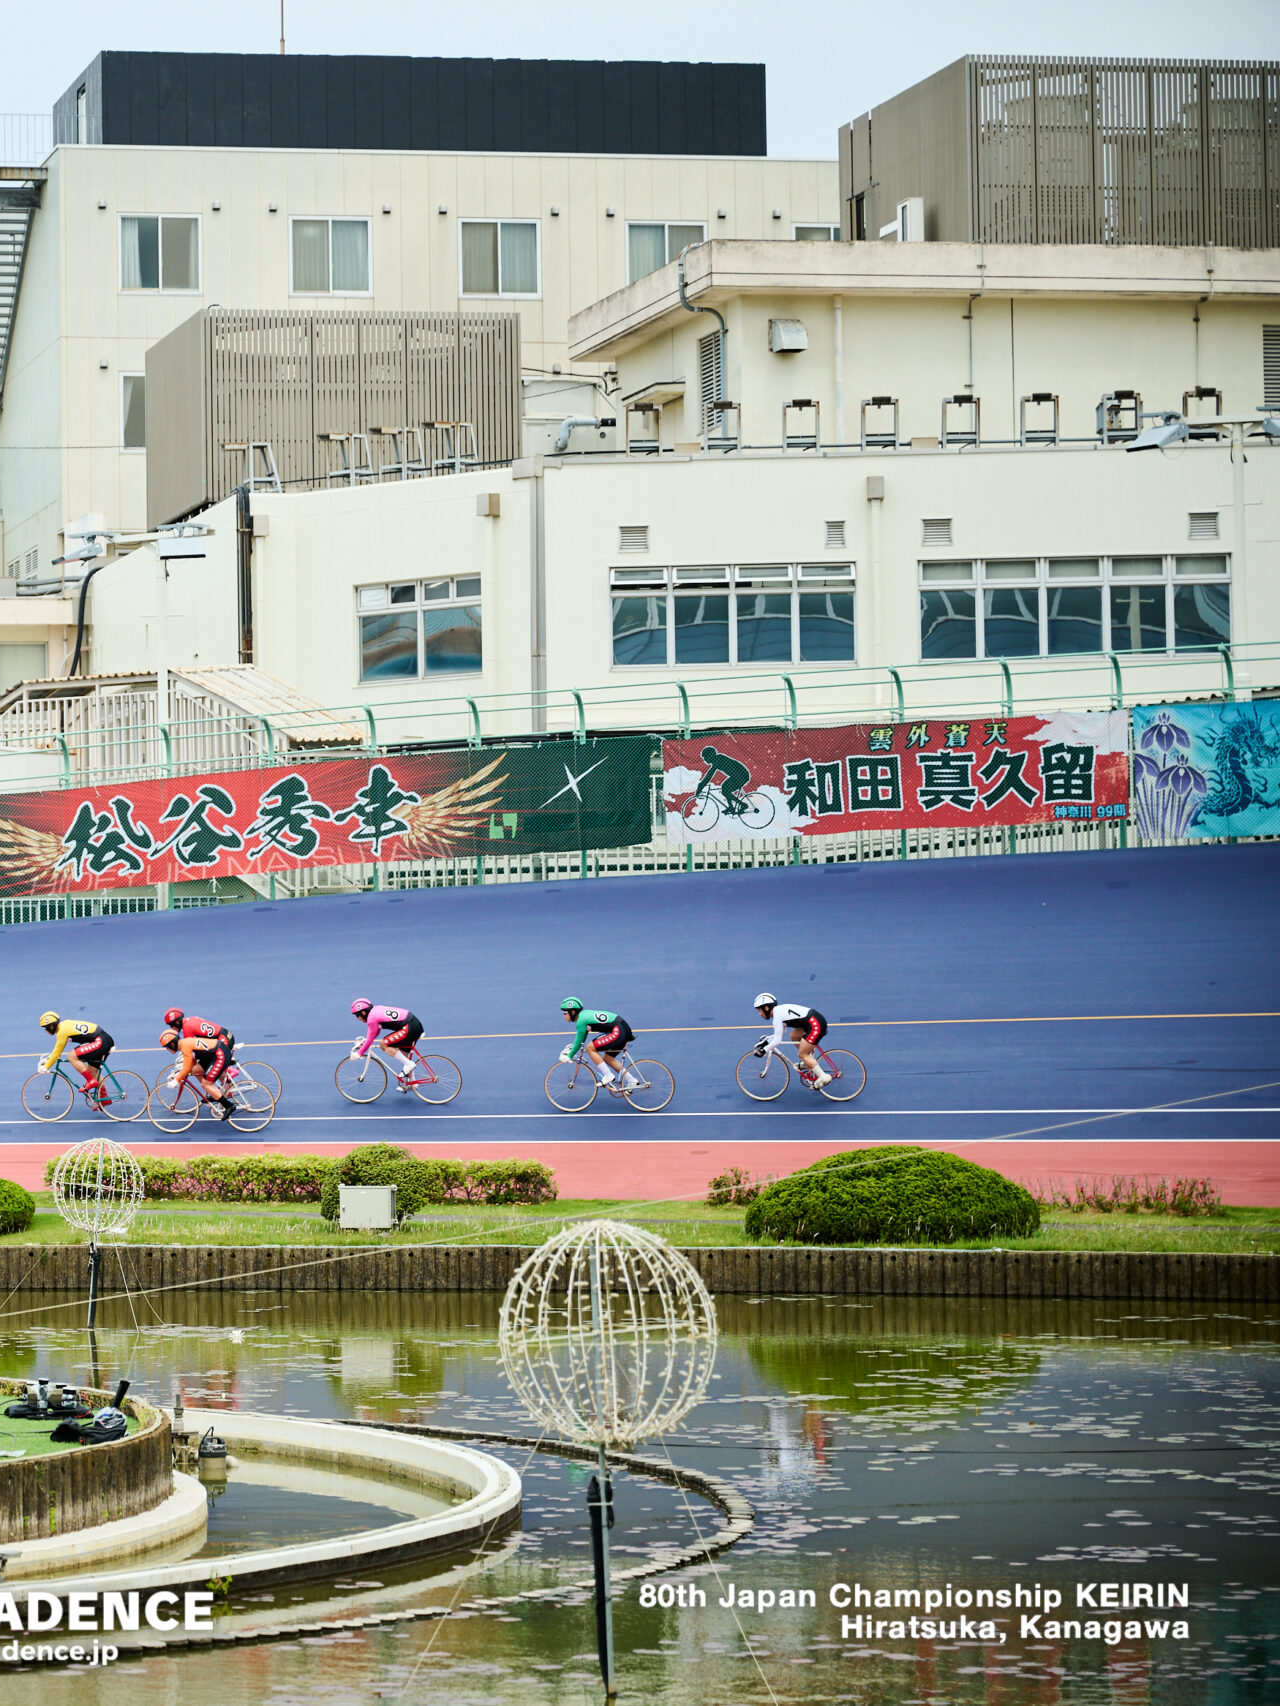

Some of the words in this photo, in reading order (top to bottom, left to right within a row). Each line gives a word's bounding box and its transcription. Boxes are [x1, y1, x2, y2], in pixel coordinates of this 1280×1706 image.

[869, 722, 1008, 751] 雲外蒼天
[783, 754, 904, 817] 和田
[917, 743, 1096, 812] 真久留
[1054, 804, 1092, 818] 神奈川
[1096, 803, 1126, 818] 99期
[55, 763, 421, 883] 松谷秀幸
[385, 1009, 399, 1021] 8
[594, 1012, 609, 1024] 6
[787, 1008, 801, 1018] 1
[75, 1023, 89, 1035] 5
[201, 1022, 215, 1037] 3
[196, 1039, 209, 1051] 7
